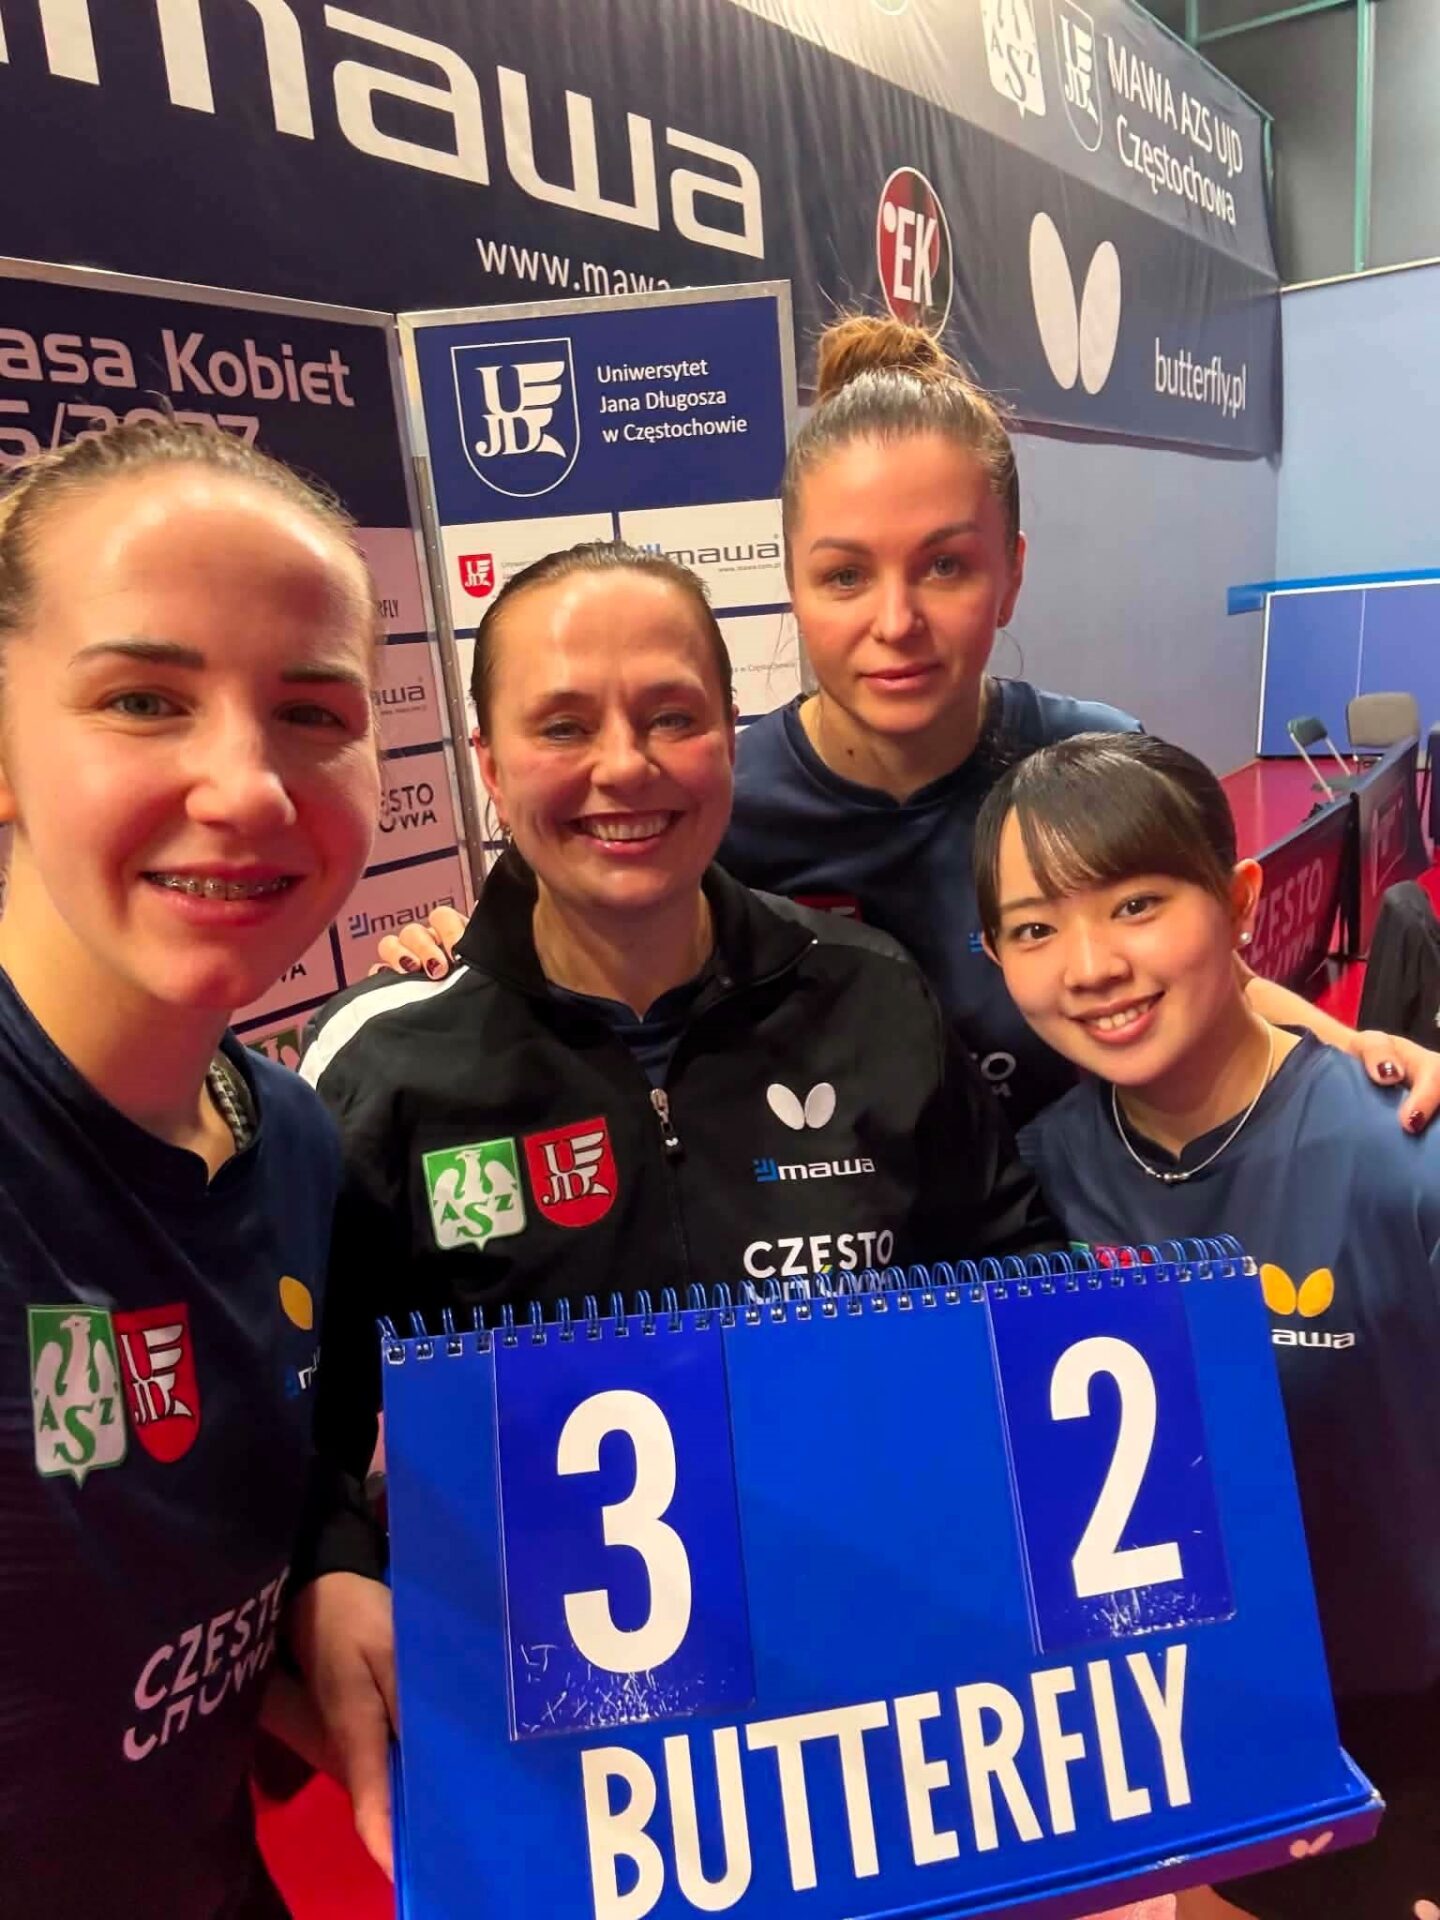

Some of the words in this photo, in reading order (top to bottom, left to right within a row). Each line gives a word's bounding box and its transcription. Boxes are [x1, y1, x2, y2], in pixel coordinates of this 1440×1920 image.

[1107, 36, 1178, 130] MAWA
[1181, 91, 1213, 153] AZS
[1215, 115, 1243, 178] UJD
[1117, 114, 1237, 226] Częstochowa
[161, 329, 354, 407] Kobiet
[597, 359, 709, 384] Uniwersytet
[600, 394, 640, 414] Jana
[645, 387, 727, 415] Długosza
[1155, 337, 1247, 419] butterfly.pl
[602, 428, 619, 443] w
[623, 414, 748, 445] Częstochowie
[664, 543, 780, 566] mawa
[778, 1157, 876, 1182] mawa
[1271, 1328, 1356, 1349] awa
[1049, 1336, 1184, 1599] 2
[556, 1389, 693, 1675] 3
[581, 1645, 1192, 1920] BUTTERFLY
